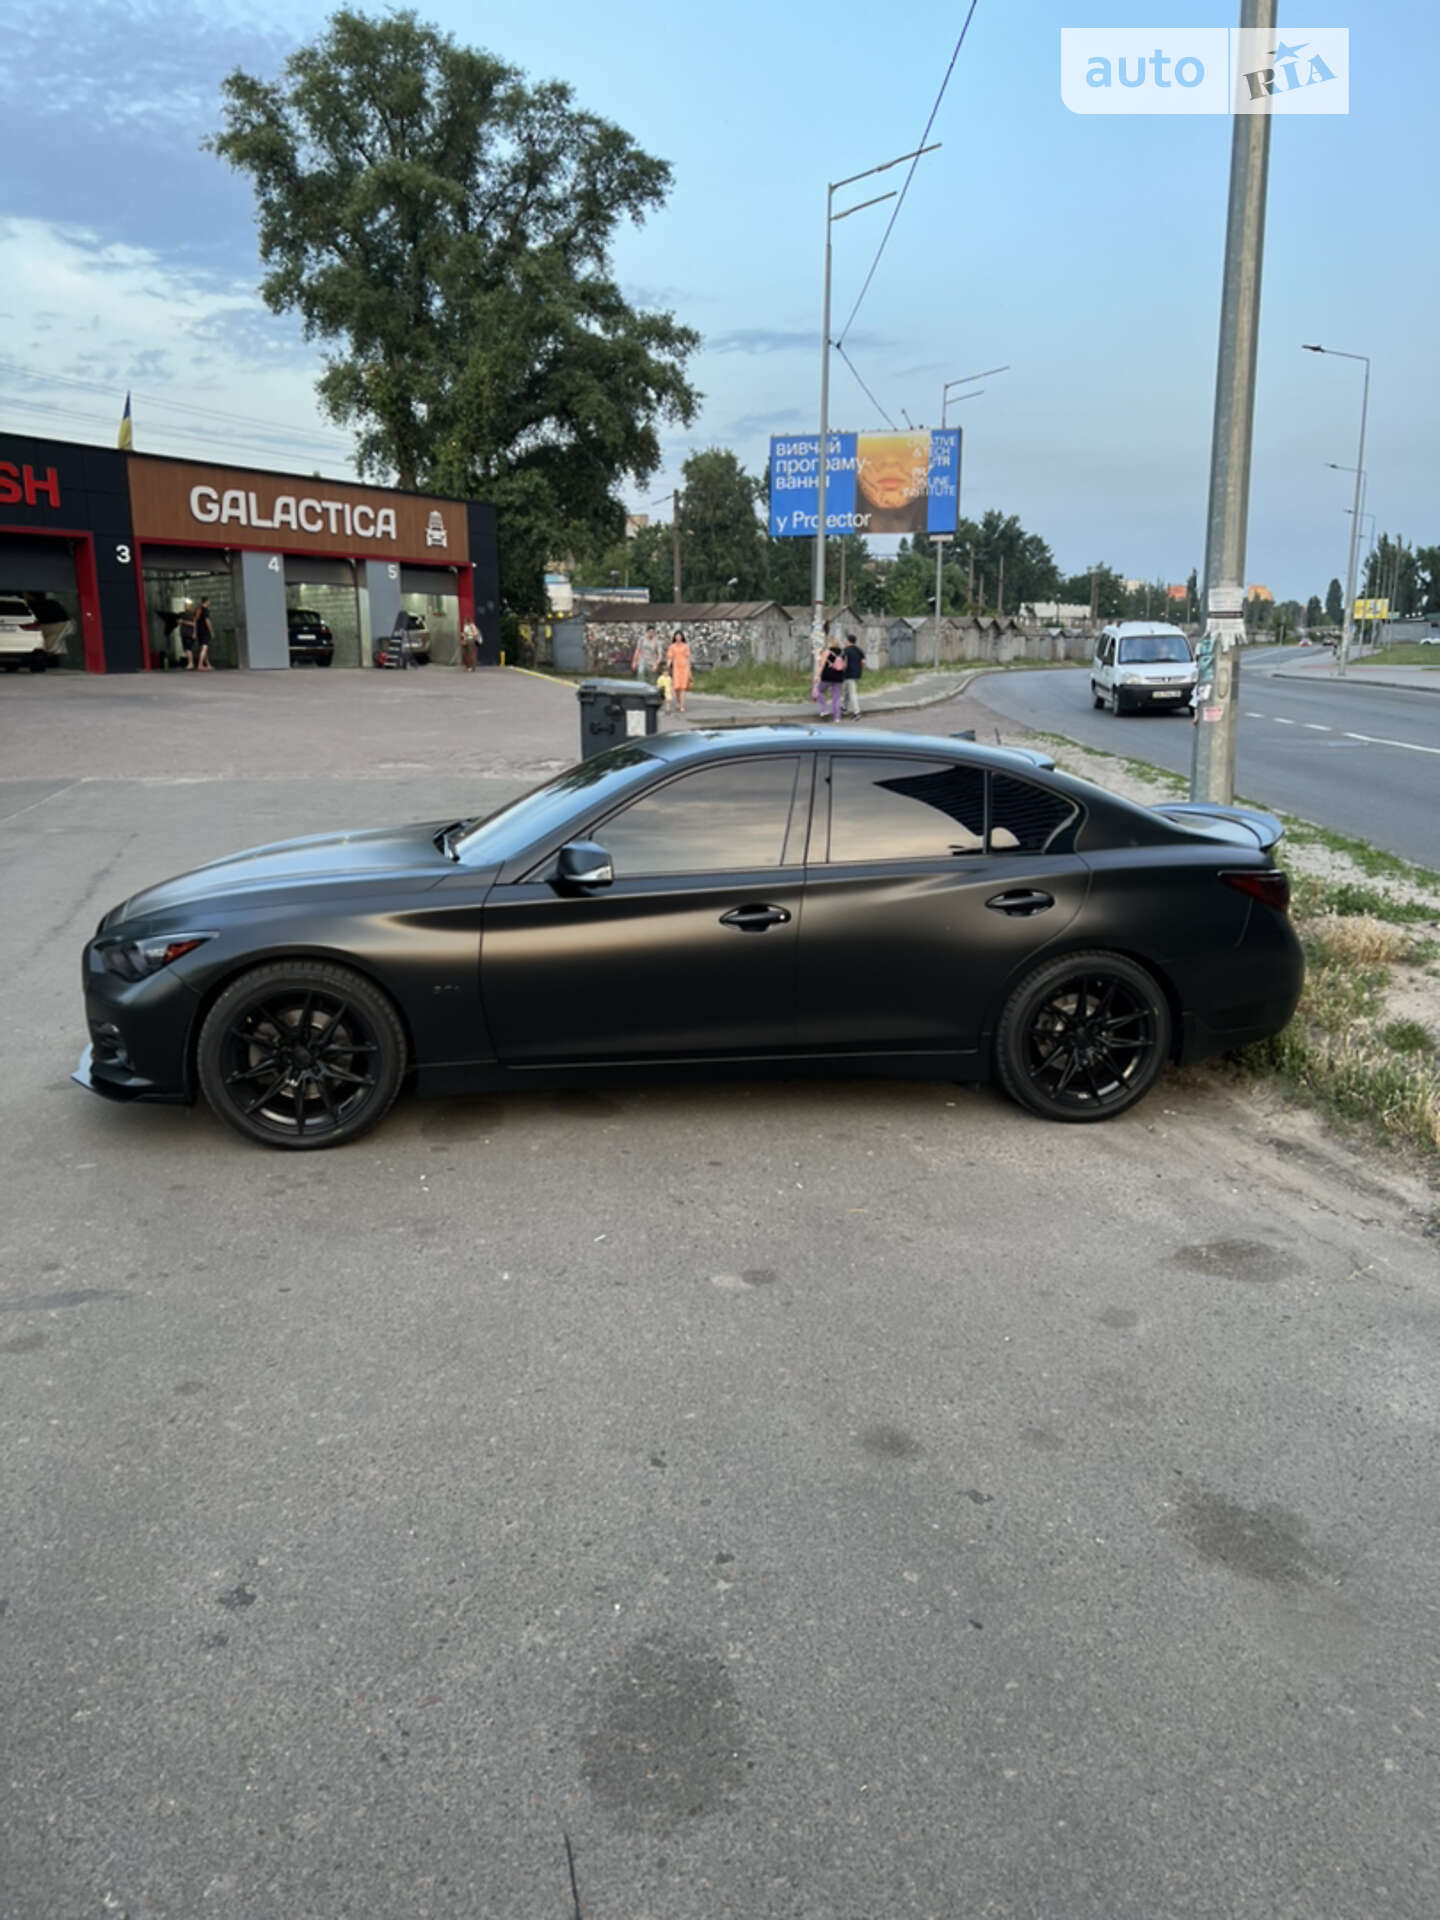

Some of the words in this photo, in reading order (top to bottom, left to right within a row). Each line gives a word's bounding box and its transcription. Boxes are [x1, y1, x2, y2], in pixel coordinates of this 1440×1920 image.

[775, 437, 843, 457] вивчй
[190, 485, 397, 540] GALACTICA
[792, 511, 874, 530] Proector
[115, 544, 131, 564] 3
[268, 555, 281, 574] 4
[387, 563, 398, 580] 5
